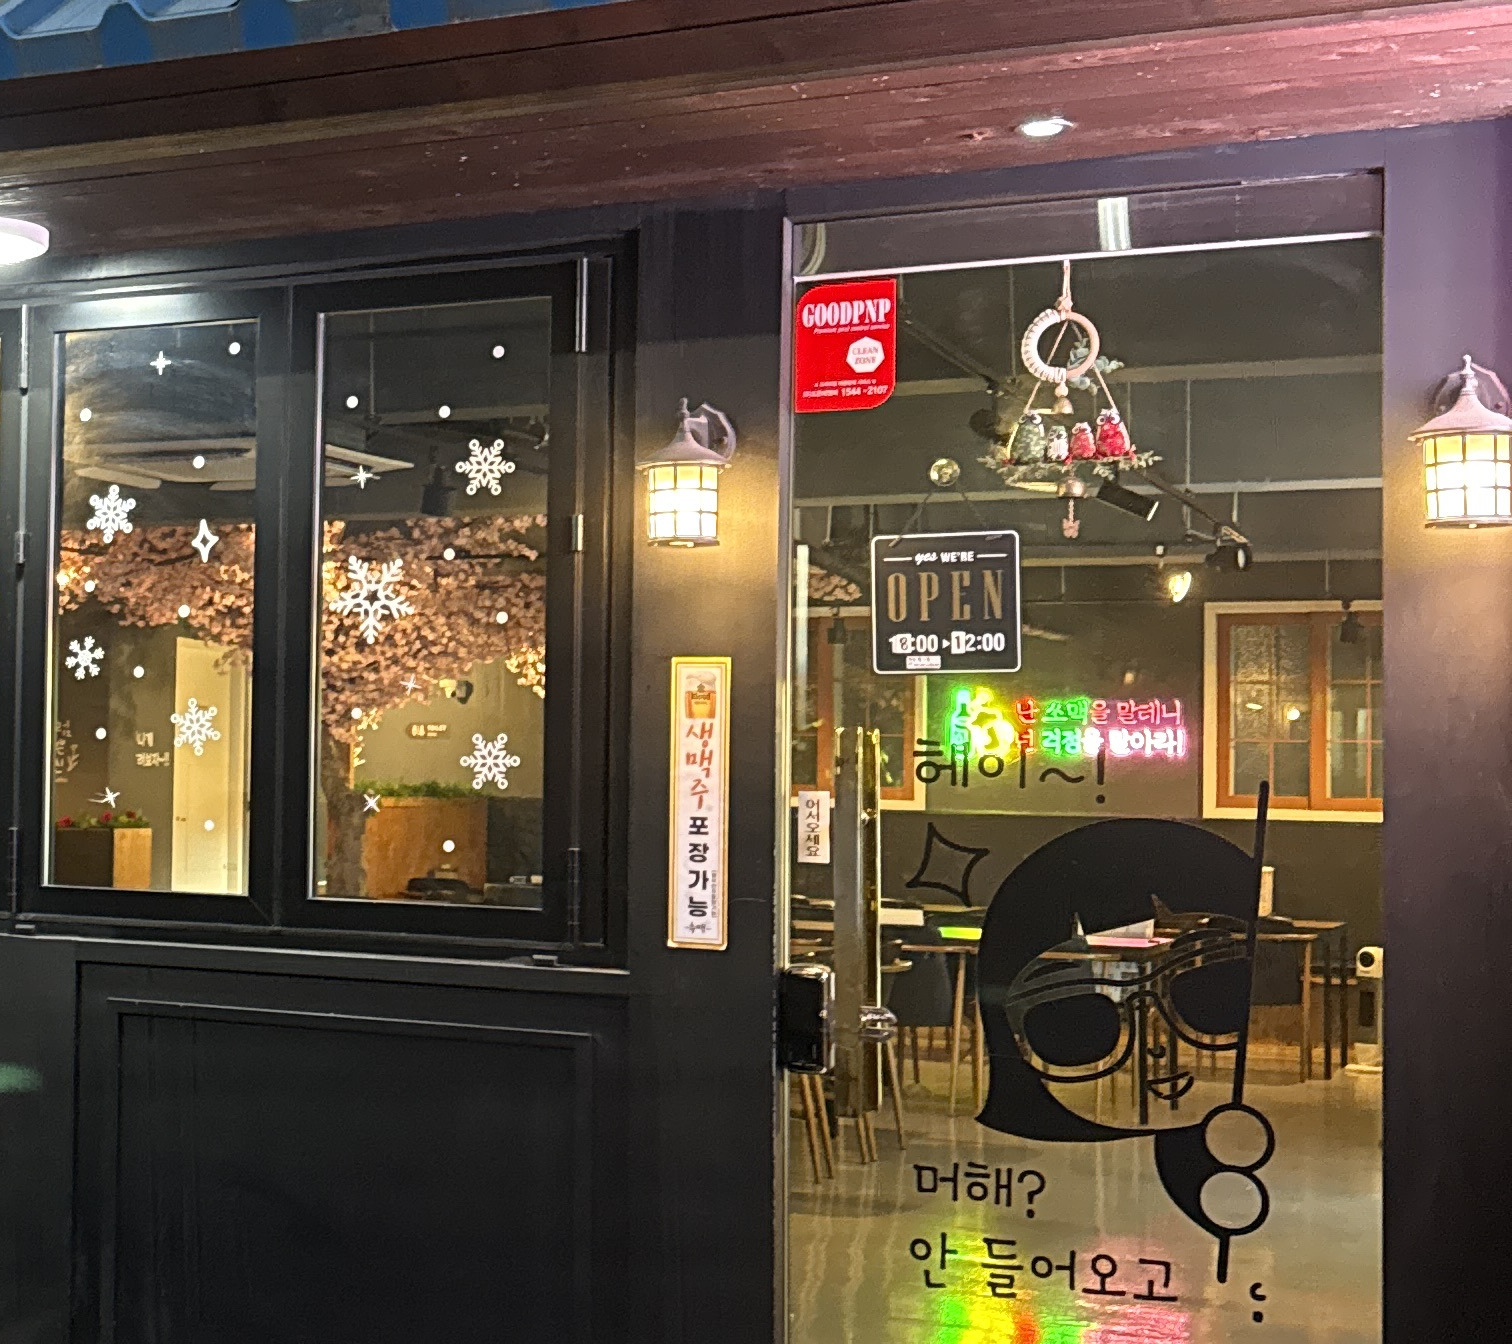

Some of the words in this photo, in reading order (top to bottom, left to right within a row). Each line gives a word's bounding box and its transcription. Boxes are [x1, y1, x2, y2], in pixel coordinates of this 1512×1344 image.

[802, 298, 891, 328] GOODPNP
[887, 570, 1004, 623] OPEN
[1016, 698, 1039, 724] 난
[1041, 698, 1110, 725] 쏘맥을
[1116, 698, 1182, 725] 말테니
[685, 721, 714, 811] 생맥주
[803, 798, 821, 857] 어서오세요
[909, 1232, 958, 1288] 안
[981, 1237, 1178, 1302] 들어오고
